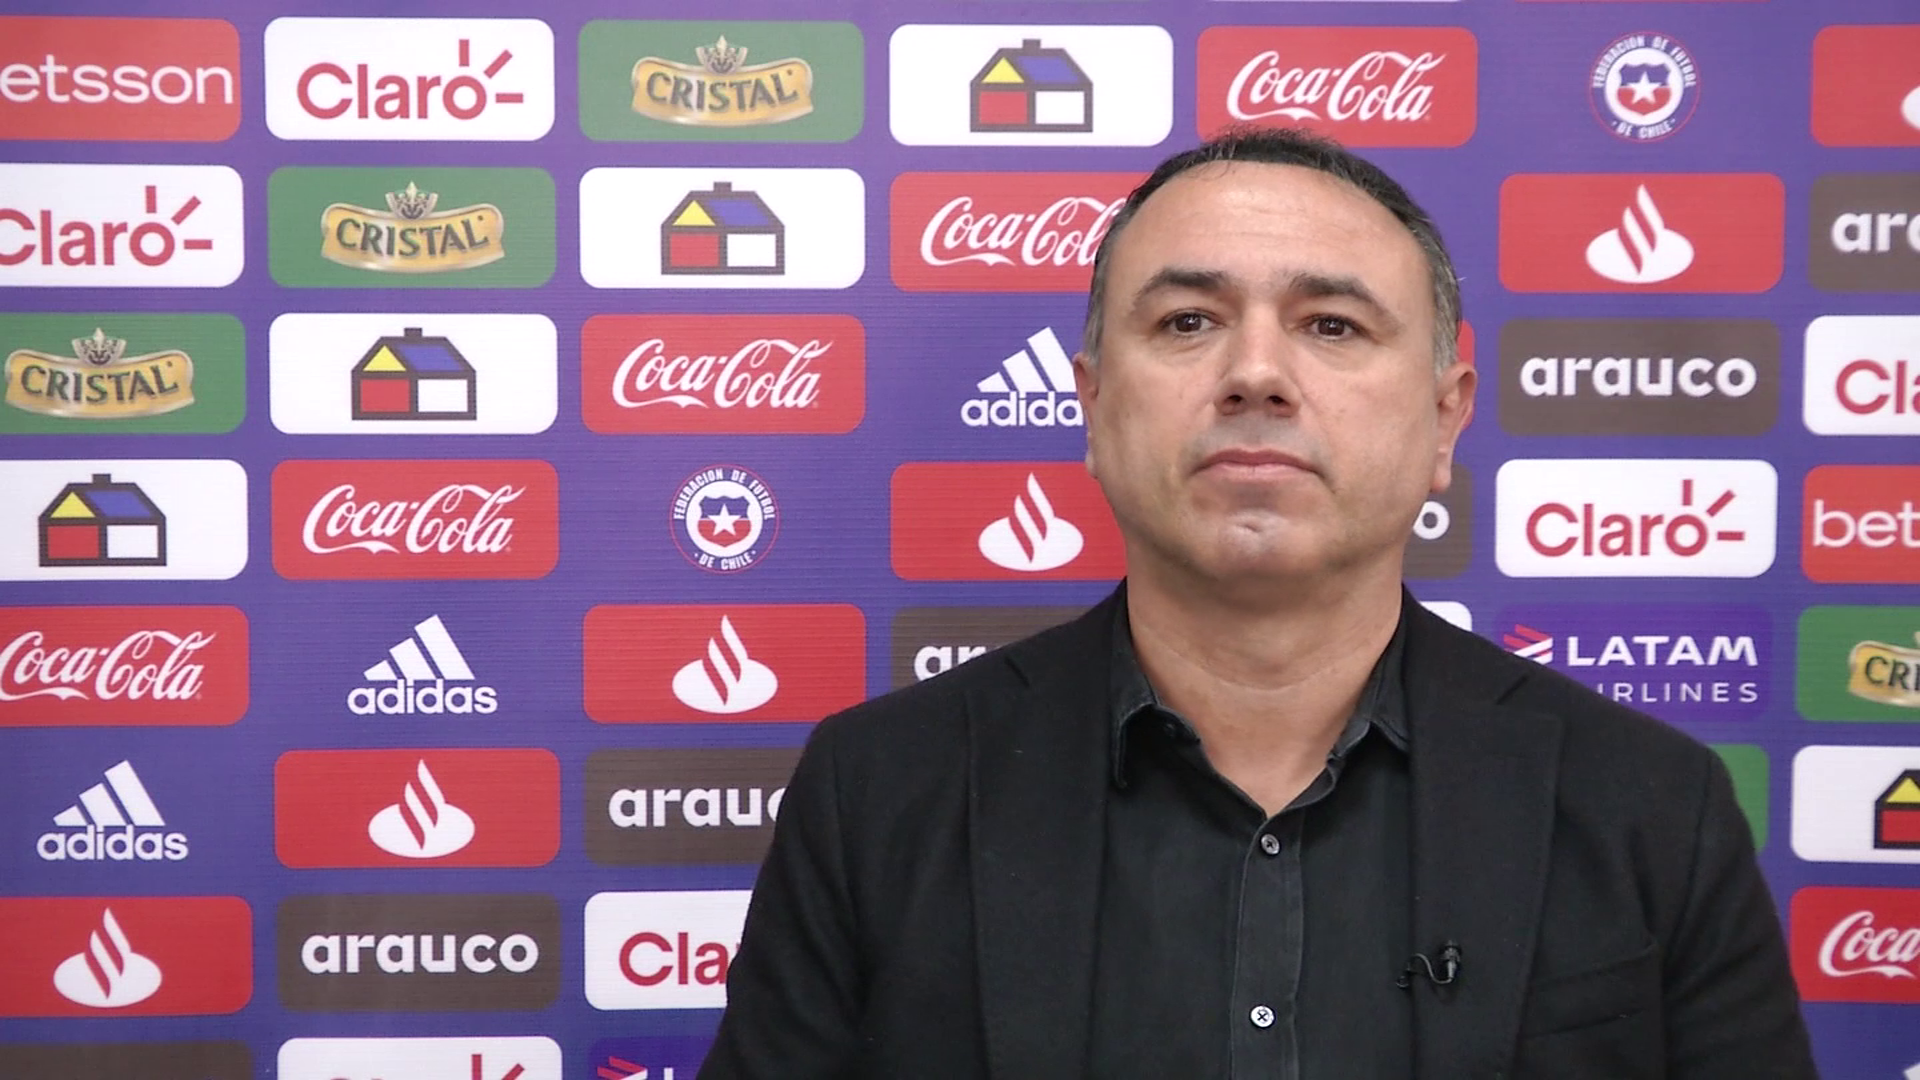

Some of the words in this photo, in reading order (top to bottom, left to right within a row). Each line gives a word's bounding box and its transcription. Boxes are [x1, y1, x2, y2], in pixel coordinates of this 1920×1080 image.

[0, 54, 234, 105] etsson
[1227, 51, 1443, 120] Coca-Cola
[1652, 37, 1669, 50] DE
[1670, 46, 1697, 88] FUTBOL
[298, 62, 487, 120] Claro
[646, 70, 795, 113] CRISTAL
[1617, 122, 1632, 137] DE
[1638, 121, 1673, 139] CHILE
[0, 209, 175, 266] Claro
[336, 217, 486, 259] CRISTAL
[921, 196, 1127, 267] Coca-Col
[20, 364, 178, 404] CRISTAL
[613, 339, 830, 407] Coca-Cola
[1521, 358, 1756, 396] arauco
[1835, 360, 1920, 414] Cl
[961, 390, 1083, 427] adida
[303, 485, 523, 553] Coca-Cola
[673, 468, 724, 520] FEDERACION
[731, 469, 747, 483] DE
[748, 479, 776, 520] FUTBOL
[1526, 503, 1708, 557] Claro
[1814, 500, 1920, 547] bet
[698, 553, 715, 568] DE
[720, 552, 753, 570] CHILE
[0, 631, 214, 700] Coca-Cola
[1568, 636, 1757, 665] LATAM
[347, 679, 497, 714] adidas
[37, 824, 188, 860] adidas
[302, 935, 538, 973] arauco
[619, 932, 741, 987] Cla
[1819, 912, 1920, 977] Coca
